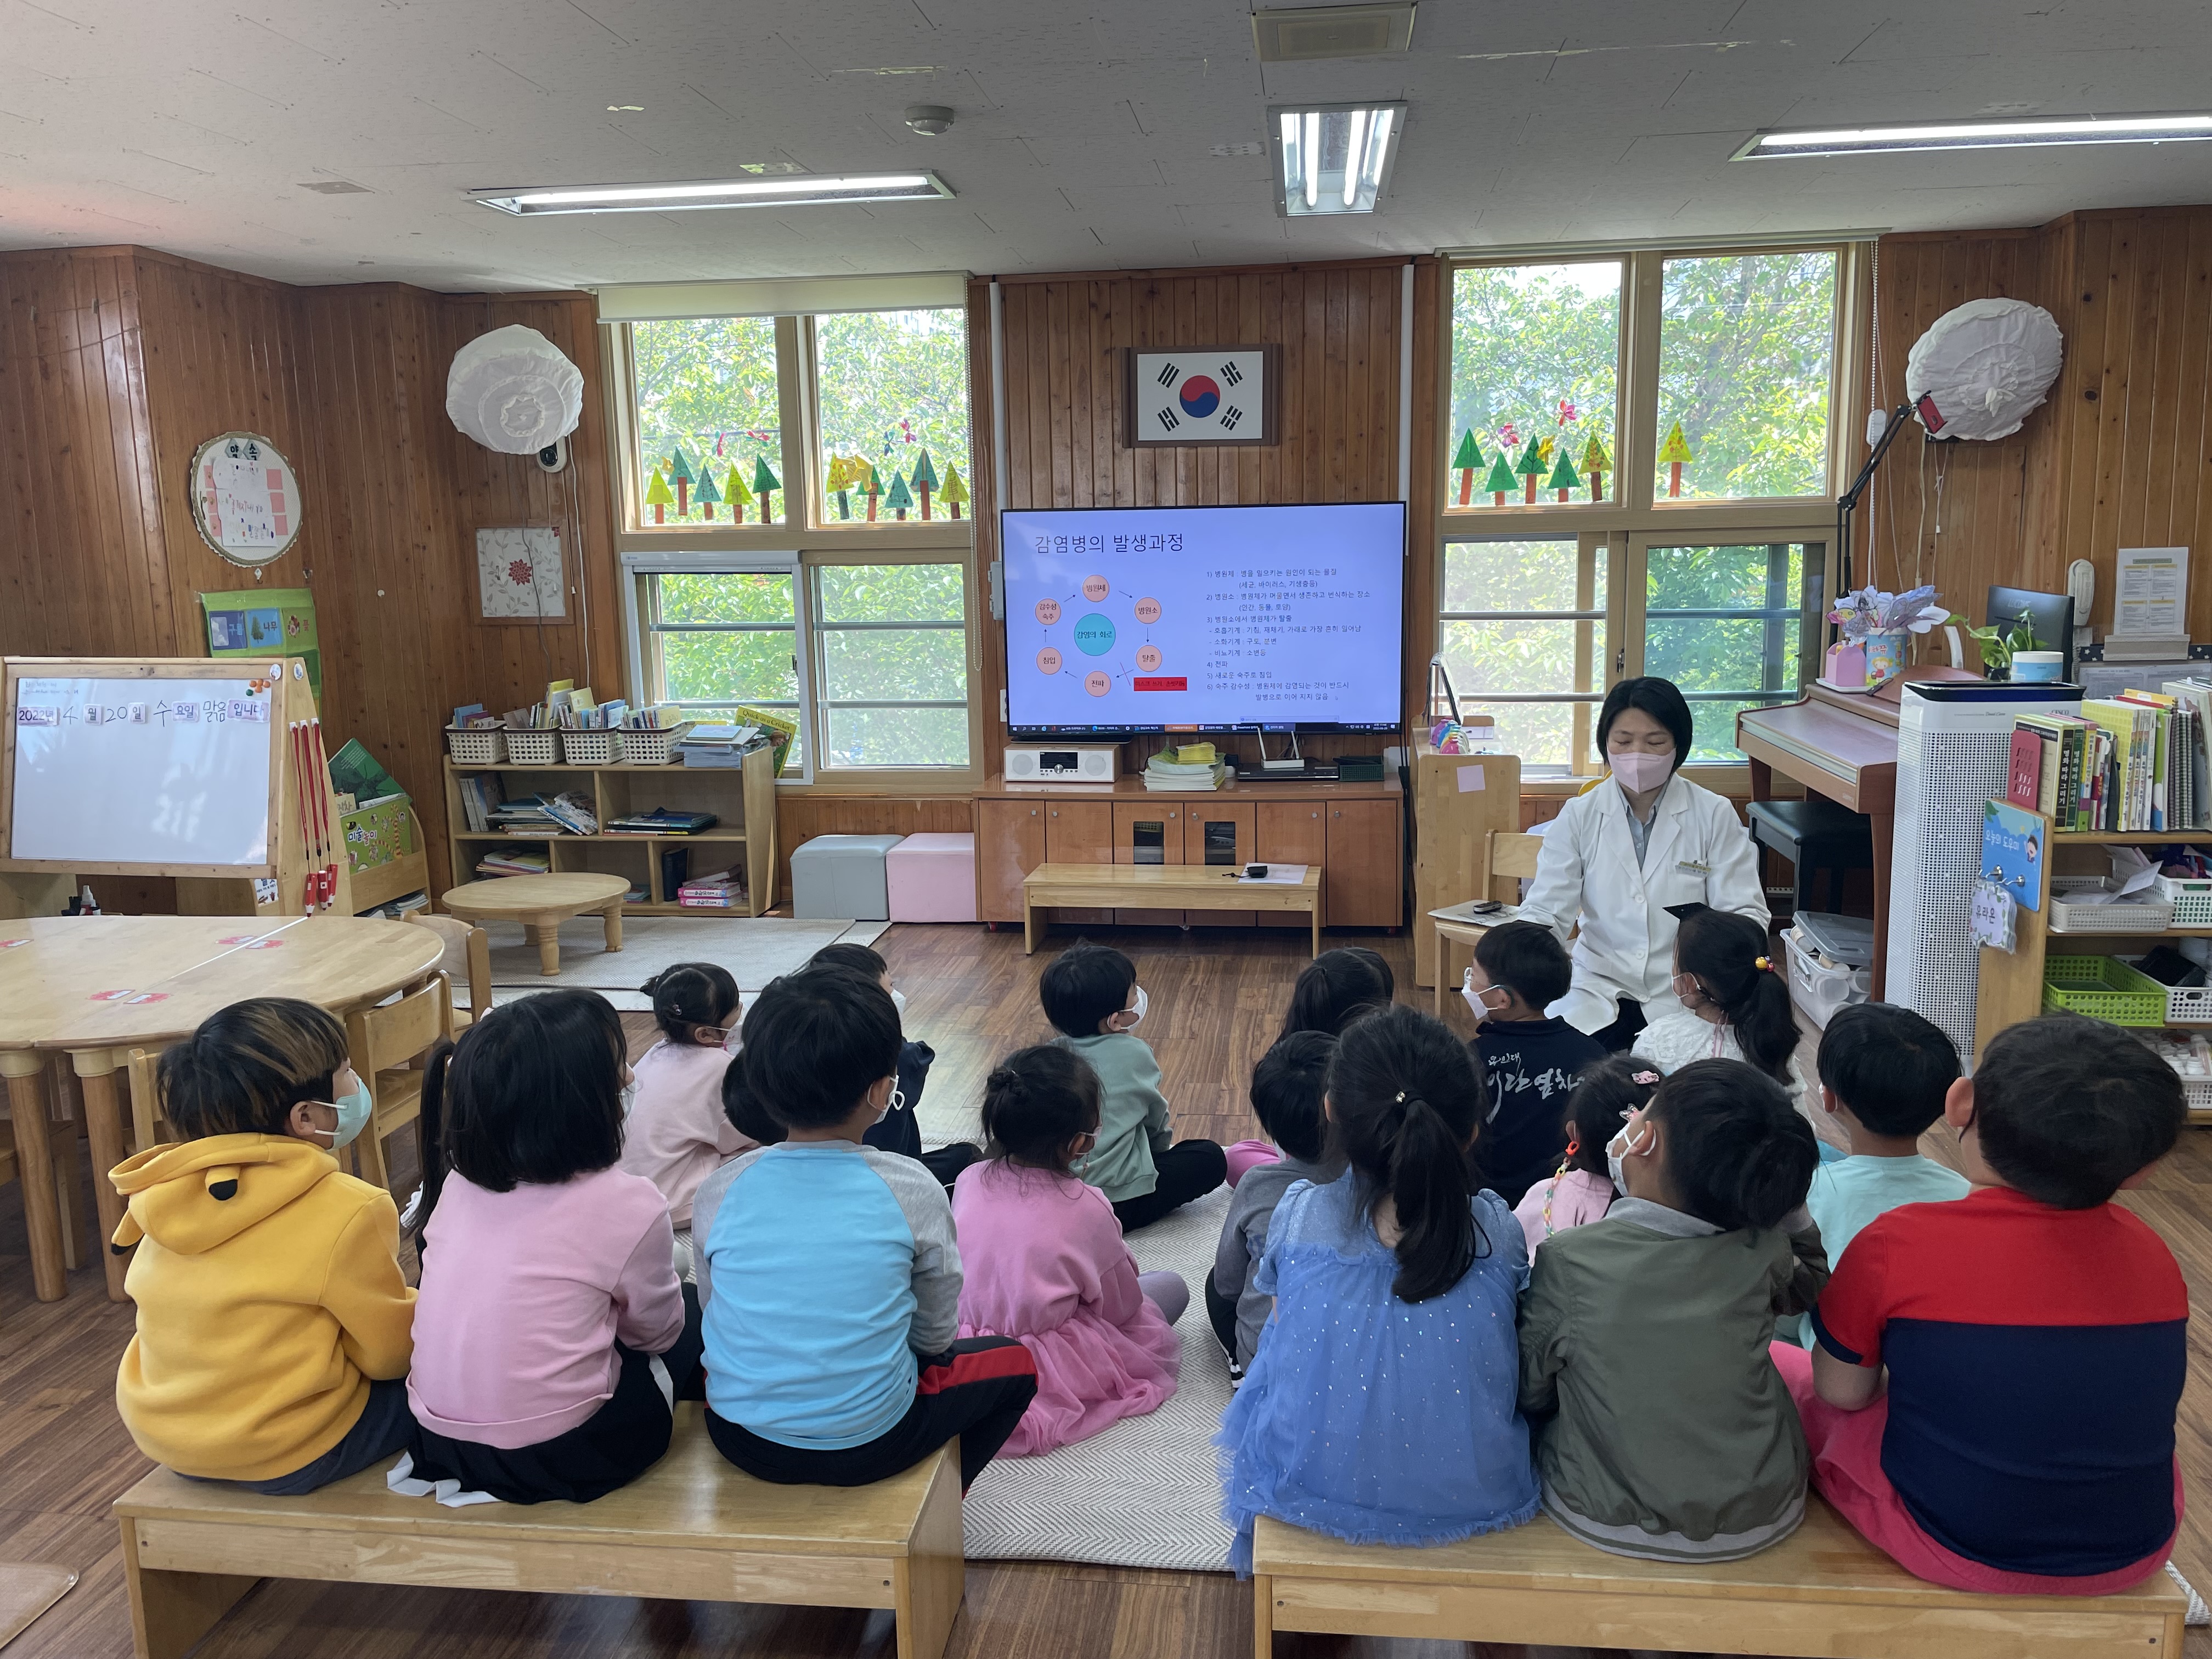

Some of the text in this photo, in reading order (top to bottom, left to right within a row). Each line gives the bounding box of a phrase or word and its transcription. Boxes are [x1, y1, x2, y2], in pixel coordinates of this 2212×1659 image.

[1036, 534, 1182, 553] 감염병의 발생과정
[264, 621, 277, 631] 나무
[19, 709, 54, 722] 2022년
[203, 700, 226, 723] 맑음
[234, 703, 264, 716] 입니다
[743, 710, 759, 720] Quick
[771, 719, 790, 731] Cricket
[2062, 749, 2070, 765] 명화
[2061, 767, 2069, 781] 따라
[2069, 751, 2080, 804] 명화 따라 그리기
[2058, 783, 2067, 805] 그리기
[349, 825, 377, 845] 미술놀이
[1985, 830, 2019, 851] 오늘의 도우미
